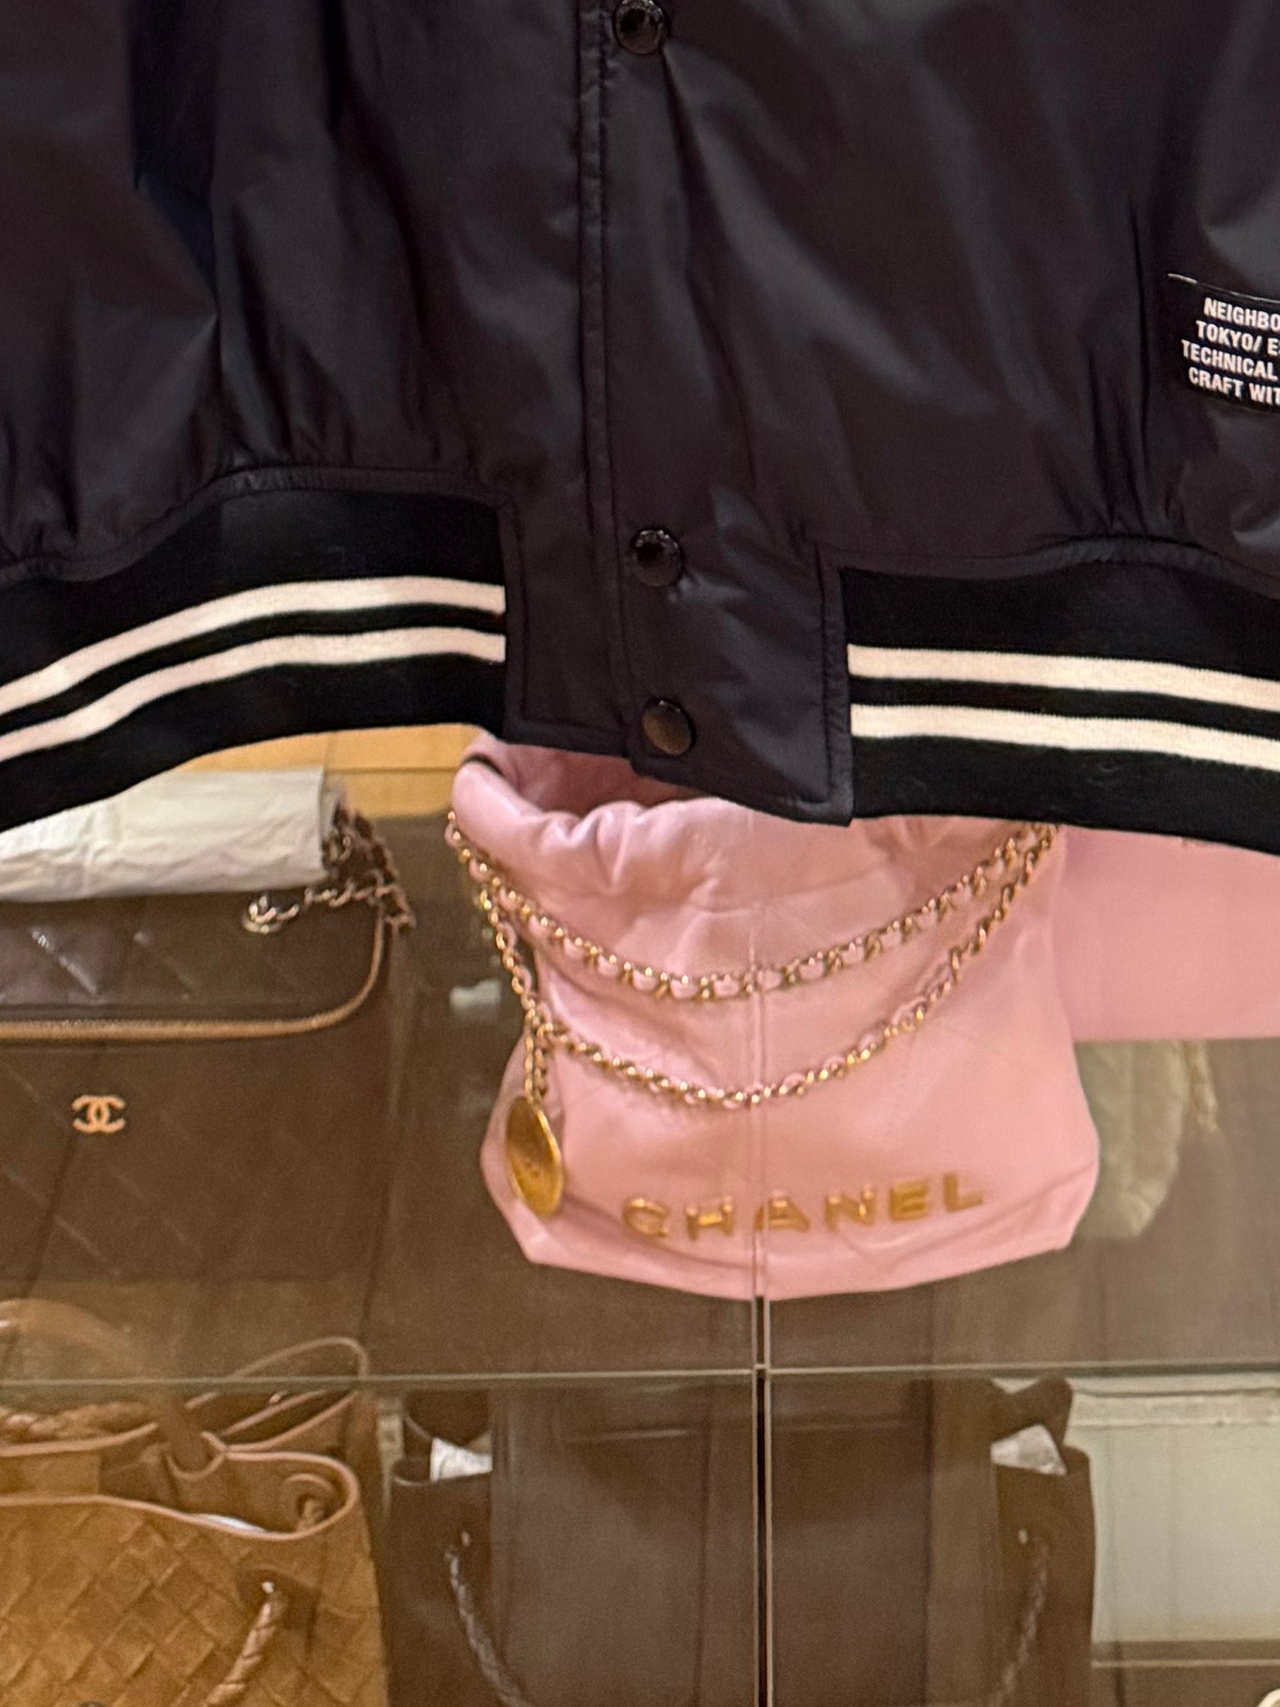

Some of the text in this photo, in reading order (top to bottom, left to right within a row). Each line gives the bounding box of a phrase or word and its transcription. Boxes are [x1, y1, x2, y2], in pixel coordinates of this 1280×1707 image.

[1181, 339, 1278, 382] TECHNICAL
[1188, 366, 1244, 399] CRAFT
[623, 1172, 985, 1242] CHANEL
